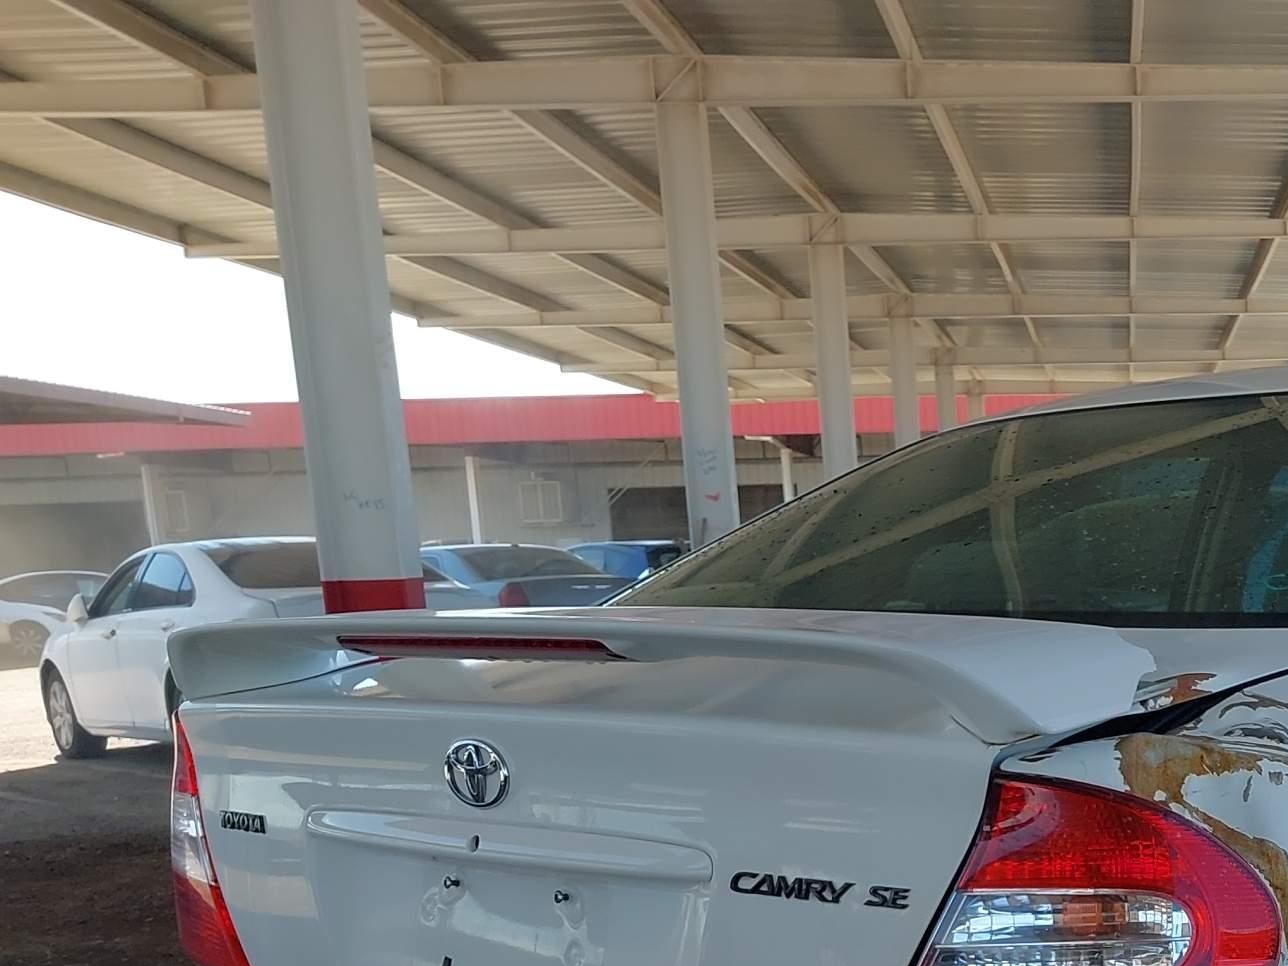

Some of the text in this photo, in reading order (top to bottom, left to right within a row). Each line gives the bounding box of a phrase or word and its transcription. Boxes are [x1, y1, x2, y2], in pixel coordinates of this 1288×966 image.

[220, 810, 266, 834] TOYOTA
[730, 871, 911, 910] CAMRY SE
